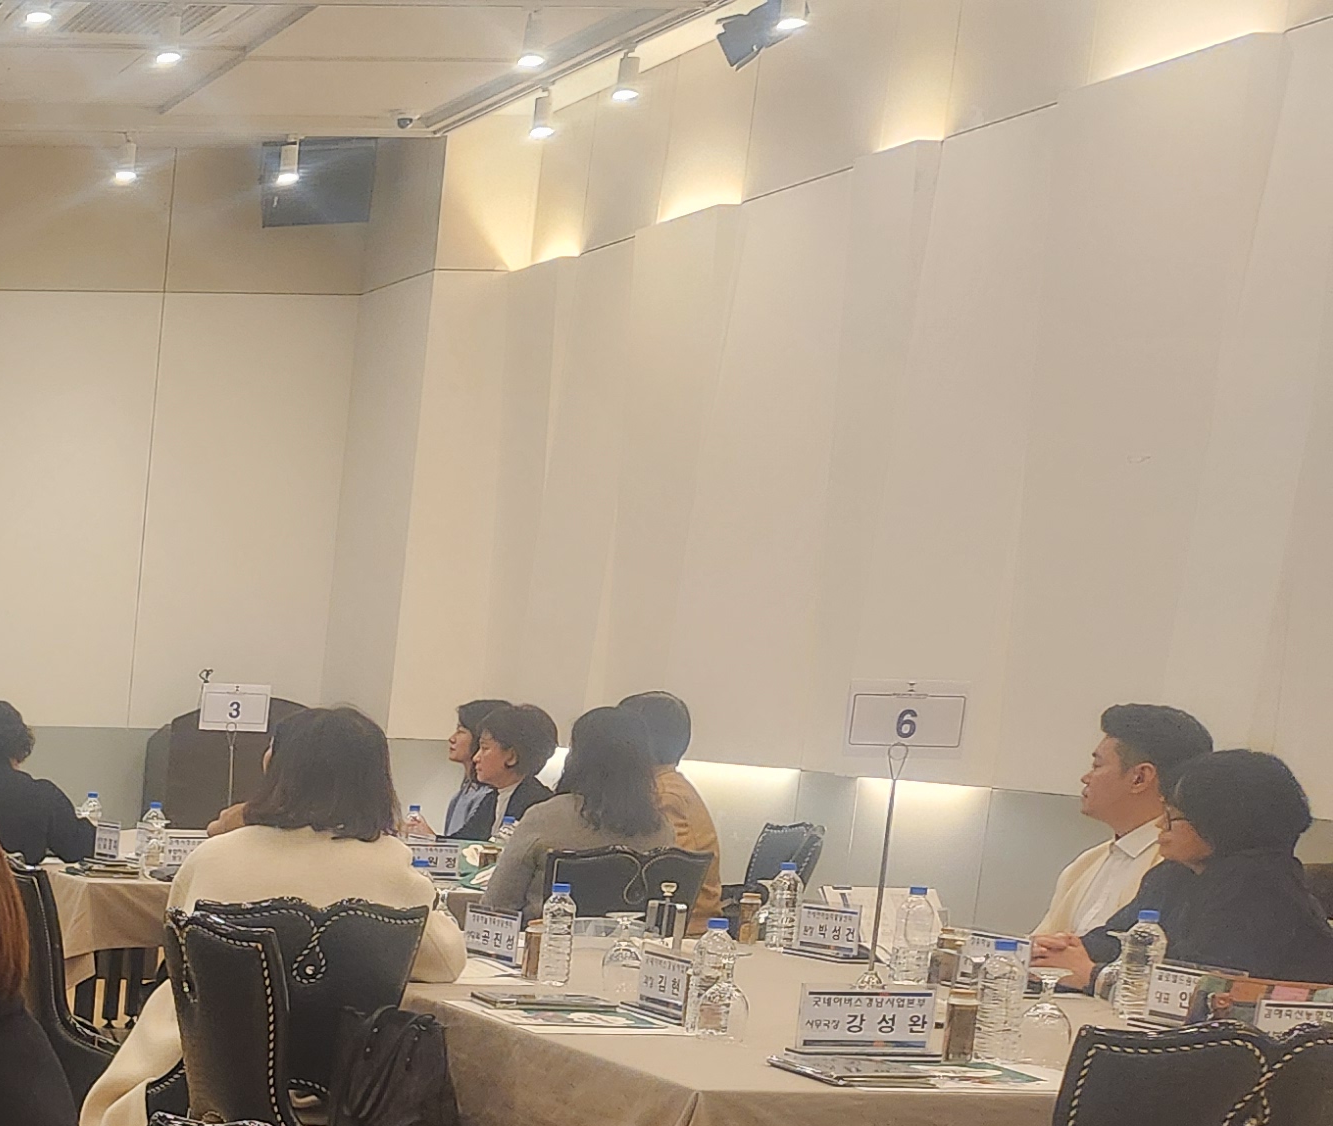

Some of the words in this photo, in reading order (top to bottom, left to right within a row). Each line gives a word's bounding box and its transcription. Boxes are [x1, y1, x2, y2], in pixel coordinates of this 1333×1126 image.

[227, 701, 241, 719] 3
[896, 708, 918, 739] 6
[818, 923, 829, 940] 박
[831, 927, 843, 941] 성
[845, 927, 855, 944] 건
[657, 973, 668, 994] 김
[812, 997, 927, 1008] 굿네이버스경남사업본부
[805, 1018, 841, 1030] 사무국장
[846, 1013, 866, 1034] 강
[877, 1014, 896, 1034] 성
[908, 1014, 928, 1034] 완
